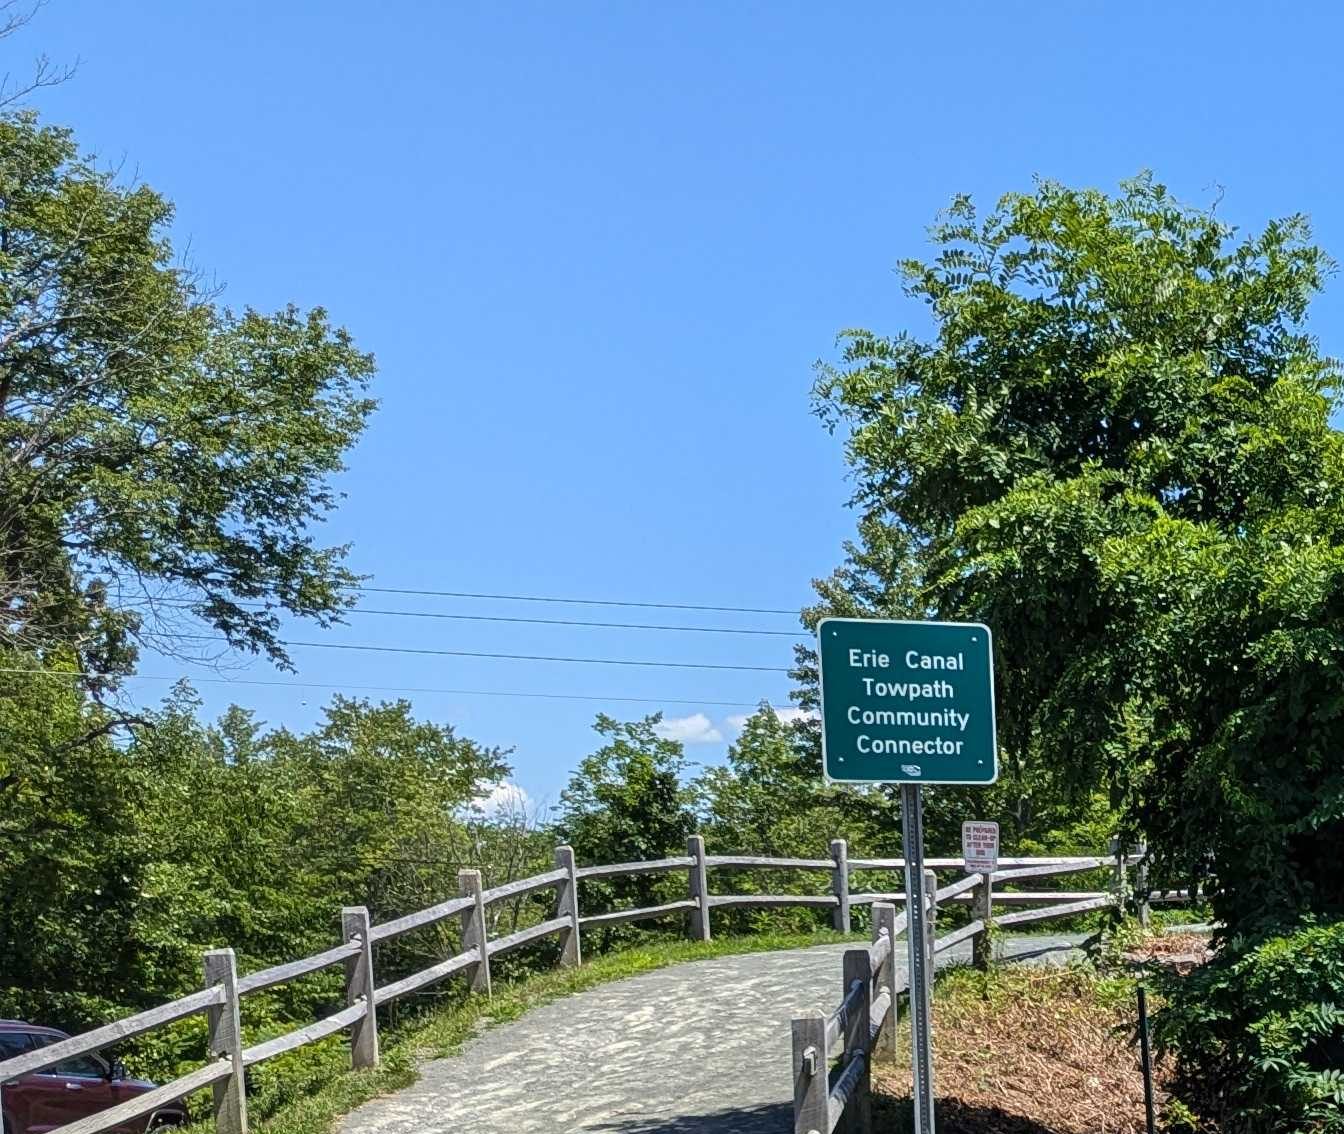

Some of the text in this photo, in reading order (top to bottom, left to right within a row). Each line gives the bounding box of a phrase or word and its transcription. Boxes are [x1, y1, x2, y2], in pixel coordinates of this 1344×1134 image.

[849, 649, 964, 671] Erie Canal
[862, 678, 954, 701] Towpath
[847, 706, 970, 731] Community
[856, 735, 964, 755] Connector
